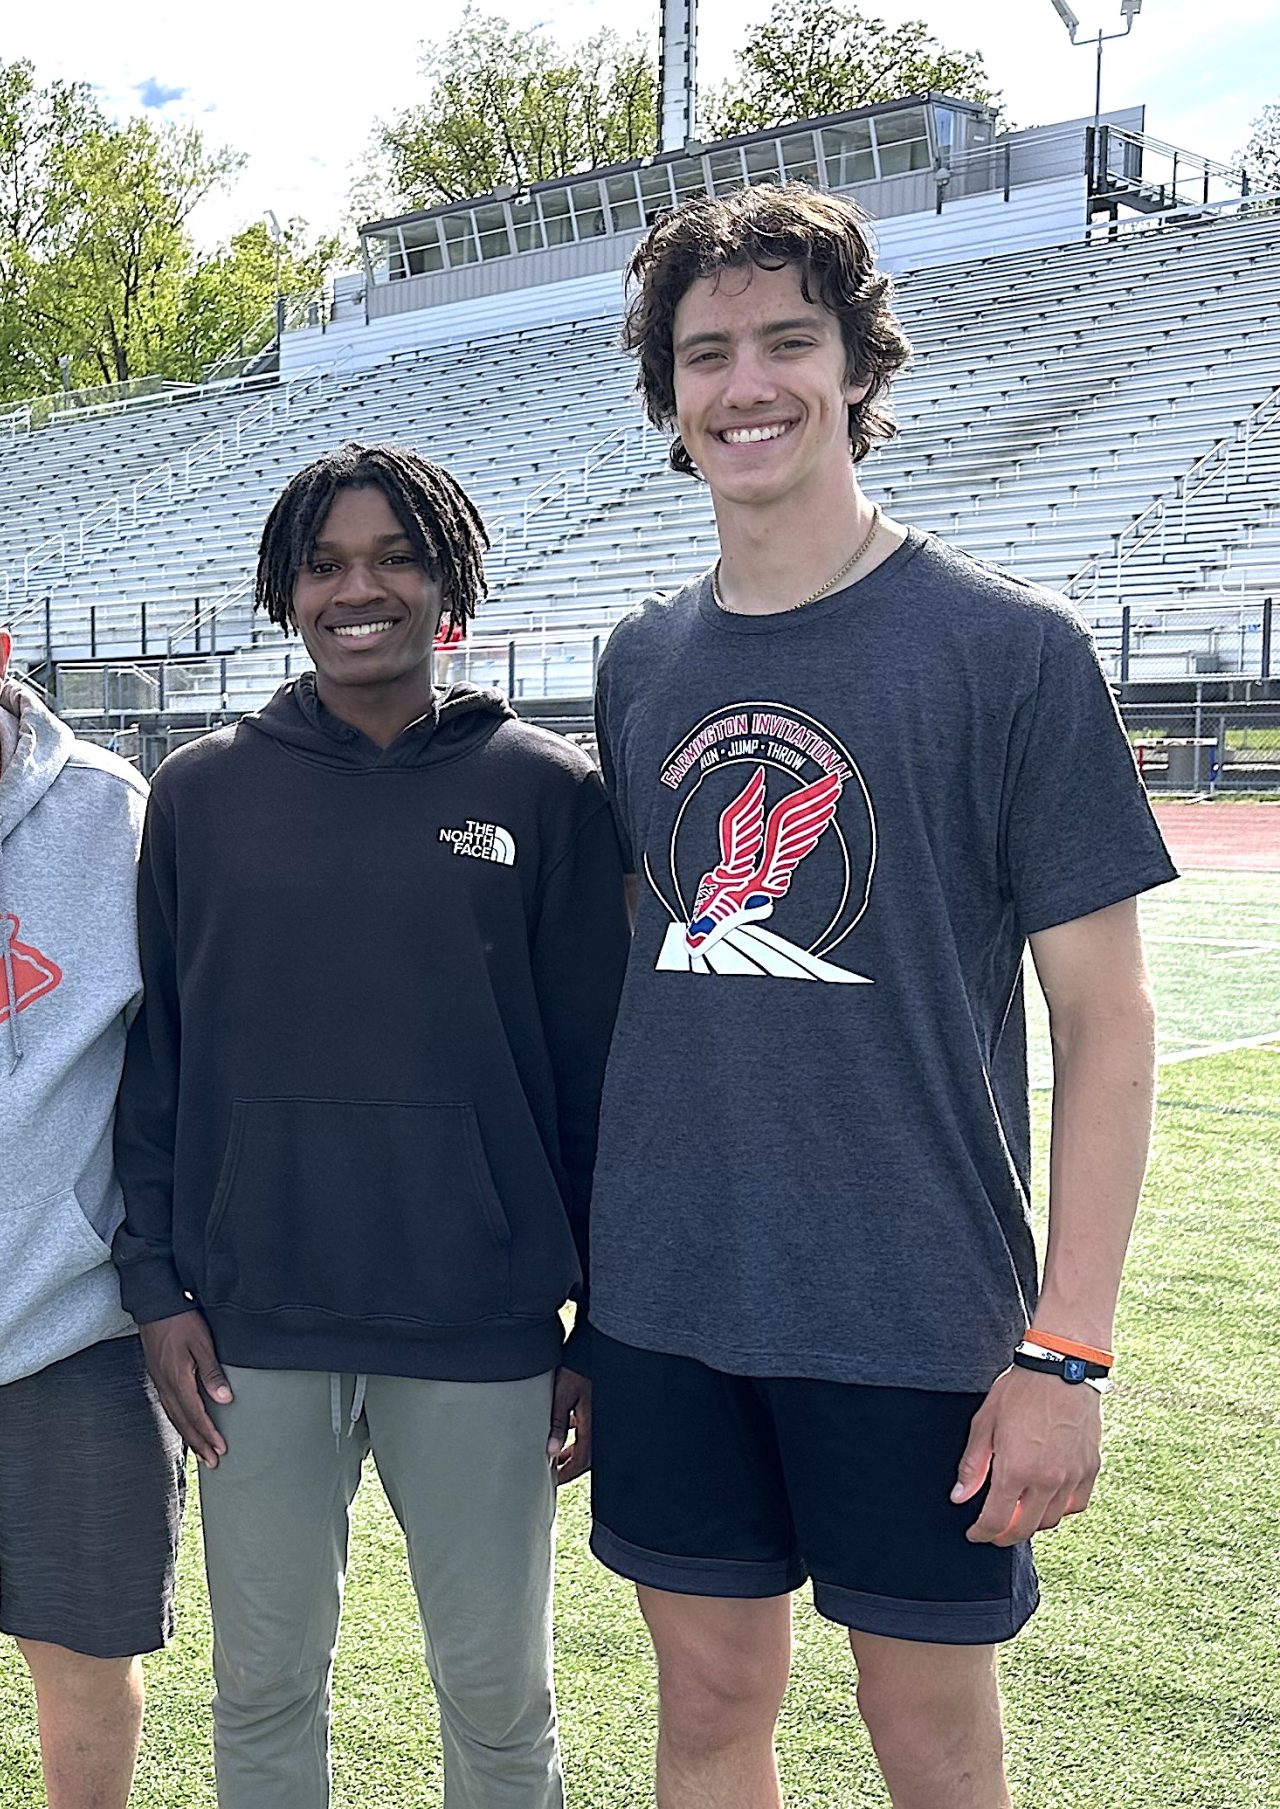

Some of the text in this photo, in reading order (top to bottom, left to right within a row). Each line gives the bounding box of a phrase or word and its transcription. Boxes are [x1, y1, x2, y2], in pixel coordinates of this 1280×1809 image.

[660, 714, 748, 790] FARMINGTON
[728, 739, 759, 757] JUMP
[766, 741, 808, 771] THROW
[465, 820, 495, 836] THE
[439, 829, 494, 848] NORTH
[453, 842, 492, 860] FACE
